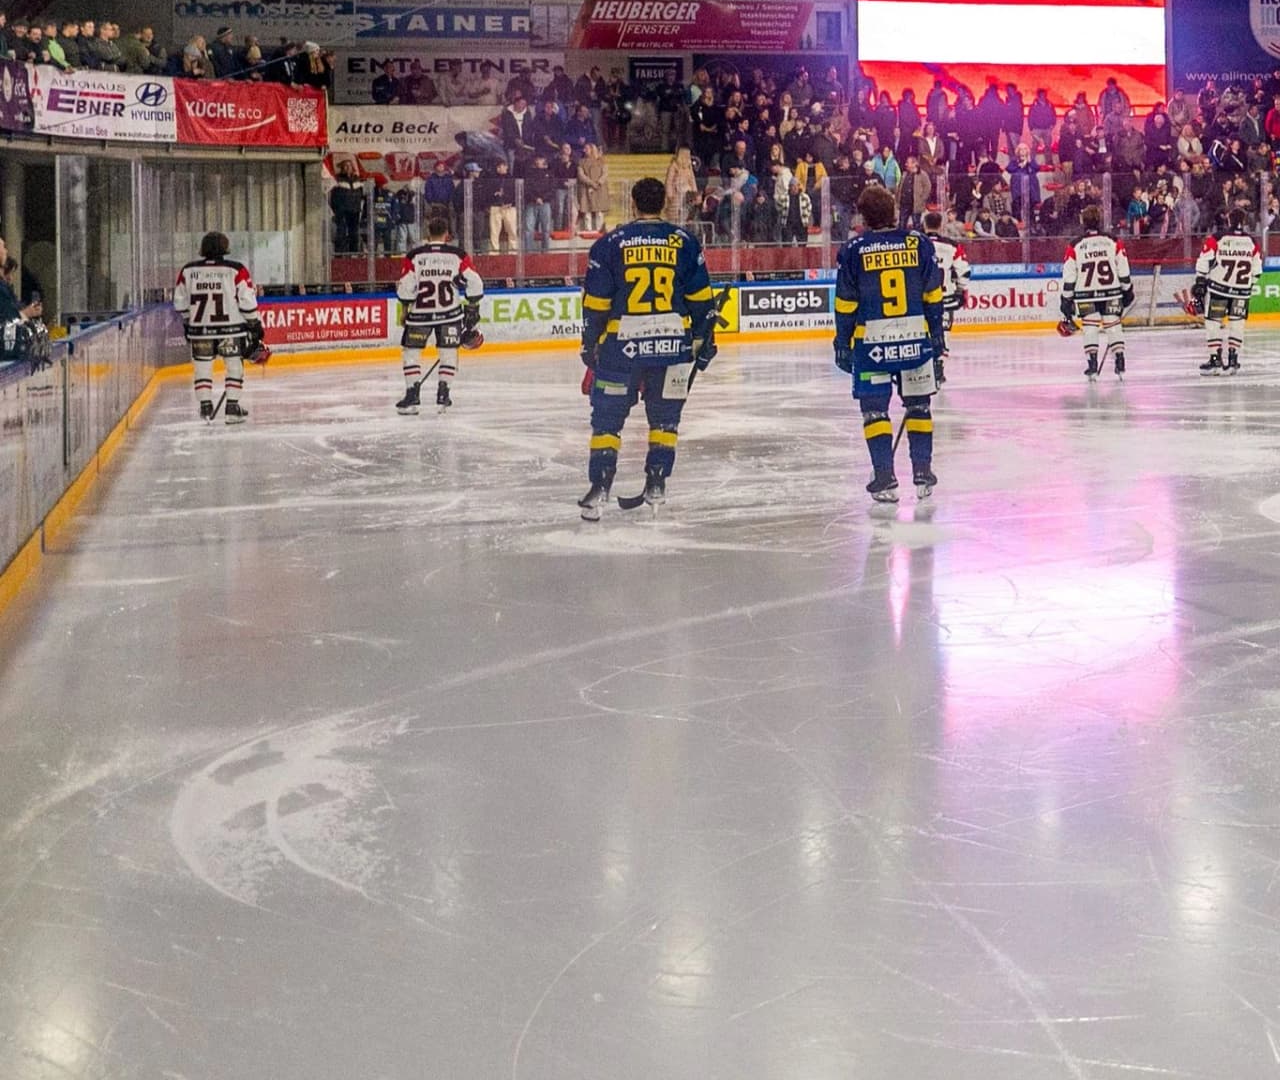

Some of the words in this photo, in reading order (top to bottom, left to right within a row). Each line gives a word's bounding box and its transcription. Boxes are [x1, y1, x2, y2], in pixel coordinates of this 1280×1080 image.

[591, 0, 700, 20] HEUBERGER
[354, 11, 530, 32] STAINER
[627, 23, 681, 35] FENSTER
[50, 77, 127, 93] AUTOHAUS
[47, 87, 126, 118] EBNER
[185, 99, 237, 119] KÜCHE
[131, 109, 175, 122] HYUNDAI
[336, 121, 384, 135] Auto
[391, 121, 440, 135] Beck
[626, 248, 675, 263] PUTNIK
[1084, 250, 1108, 259] LYONS
[1081, 260, 1115, 287] 79
[1221, 259, 1251, 283] 72
[196, 282, 222, 291] BRUS
[416, 281, 454, 309] 20
[624, 266, 676, 314] 29
[879, 268, 908, 317] 9
[190, 293, 229, 323] 71
[749, 292, 823, 312] Leitgöb
[961, 288, 1048, 311] bsolut
[258, 306, 382, 329] KRAFT+WÄRME
[750, 320, 804, 329] BAUTRÄGER
[350, 328, 382, 338] SANITÄR
